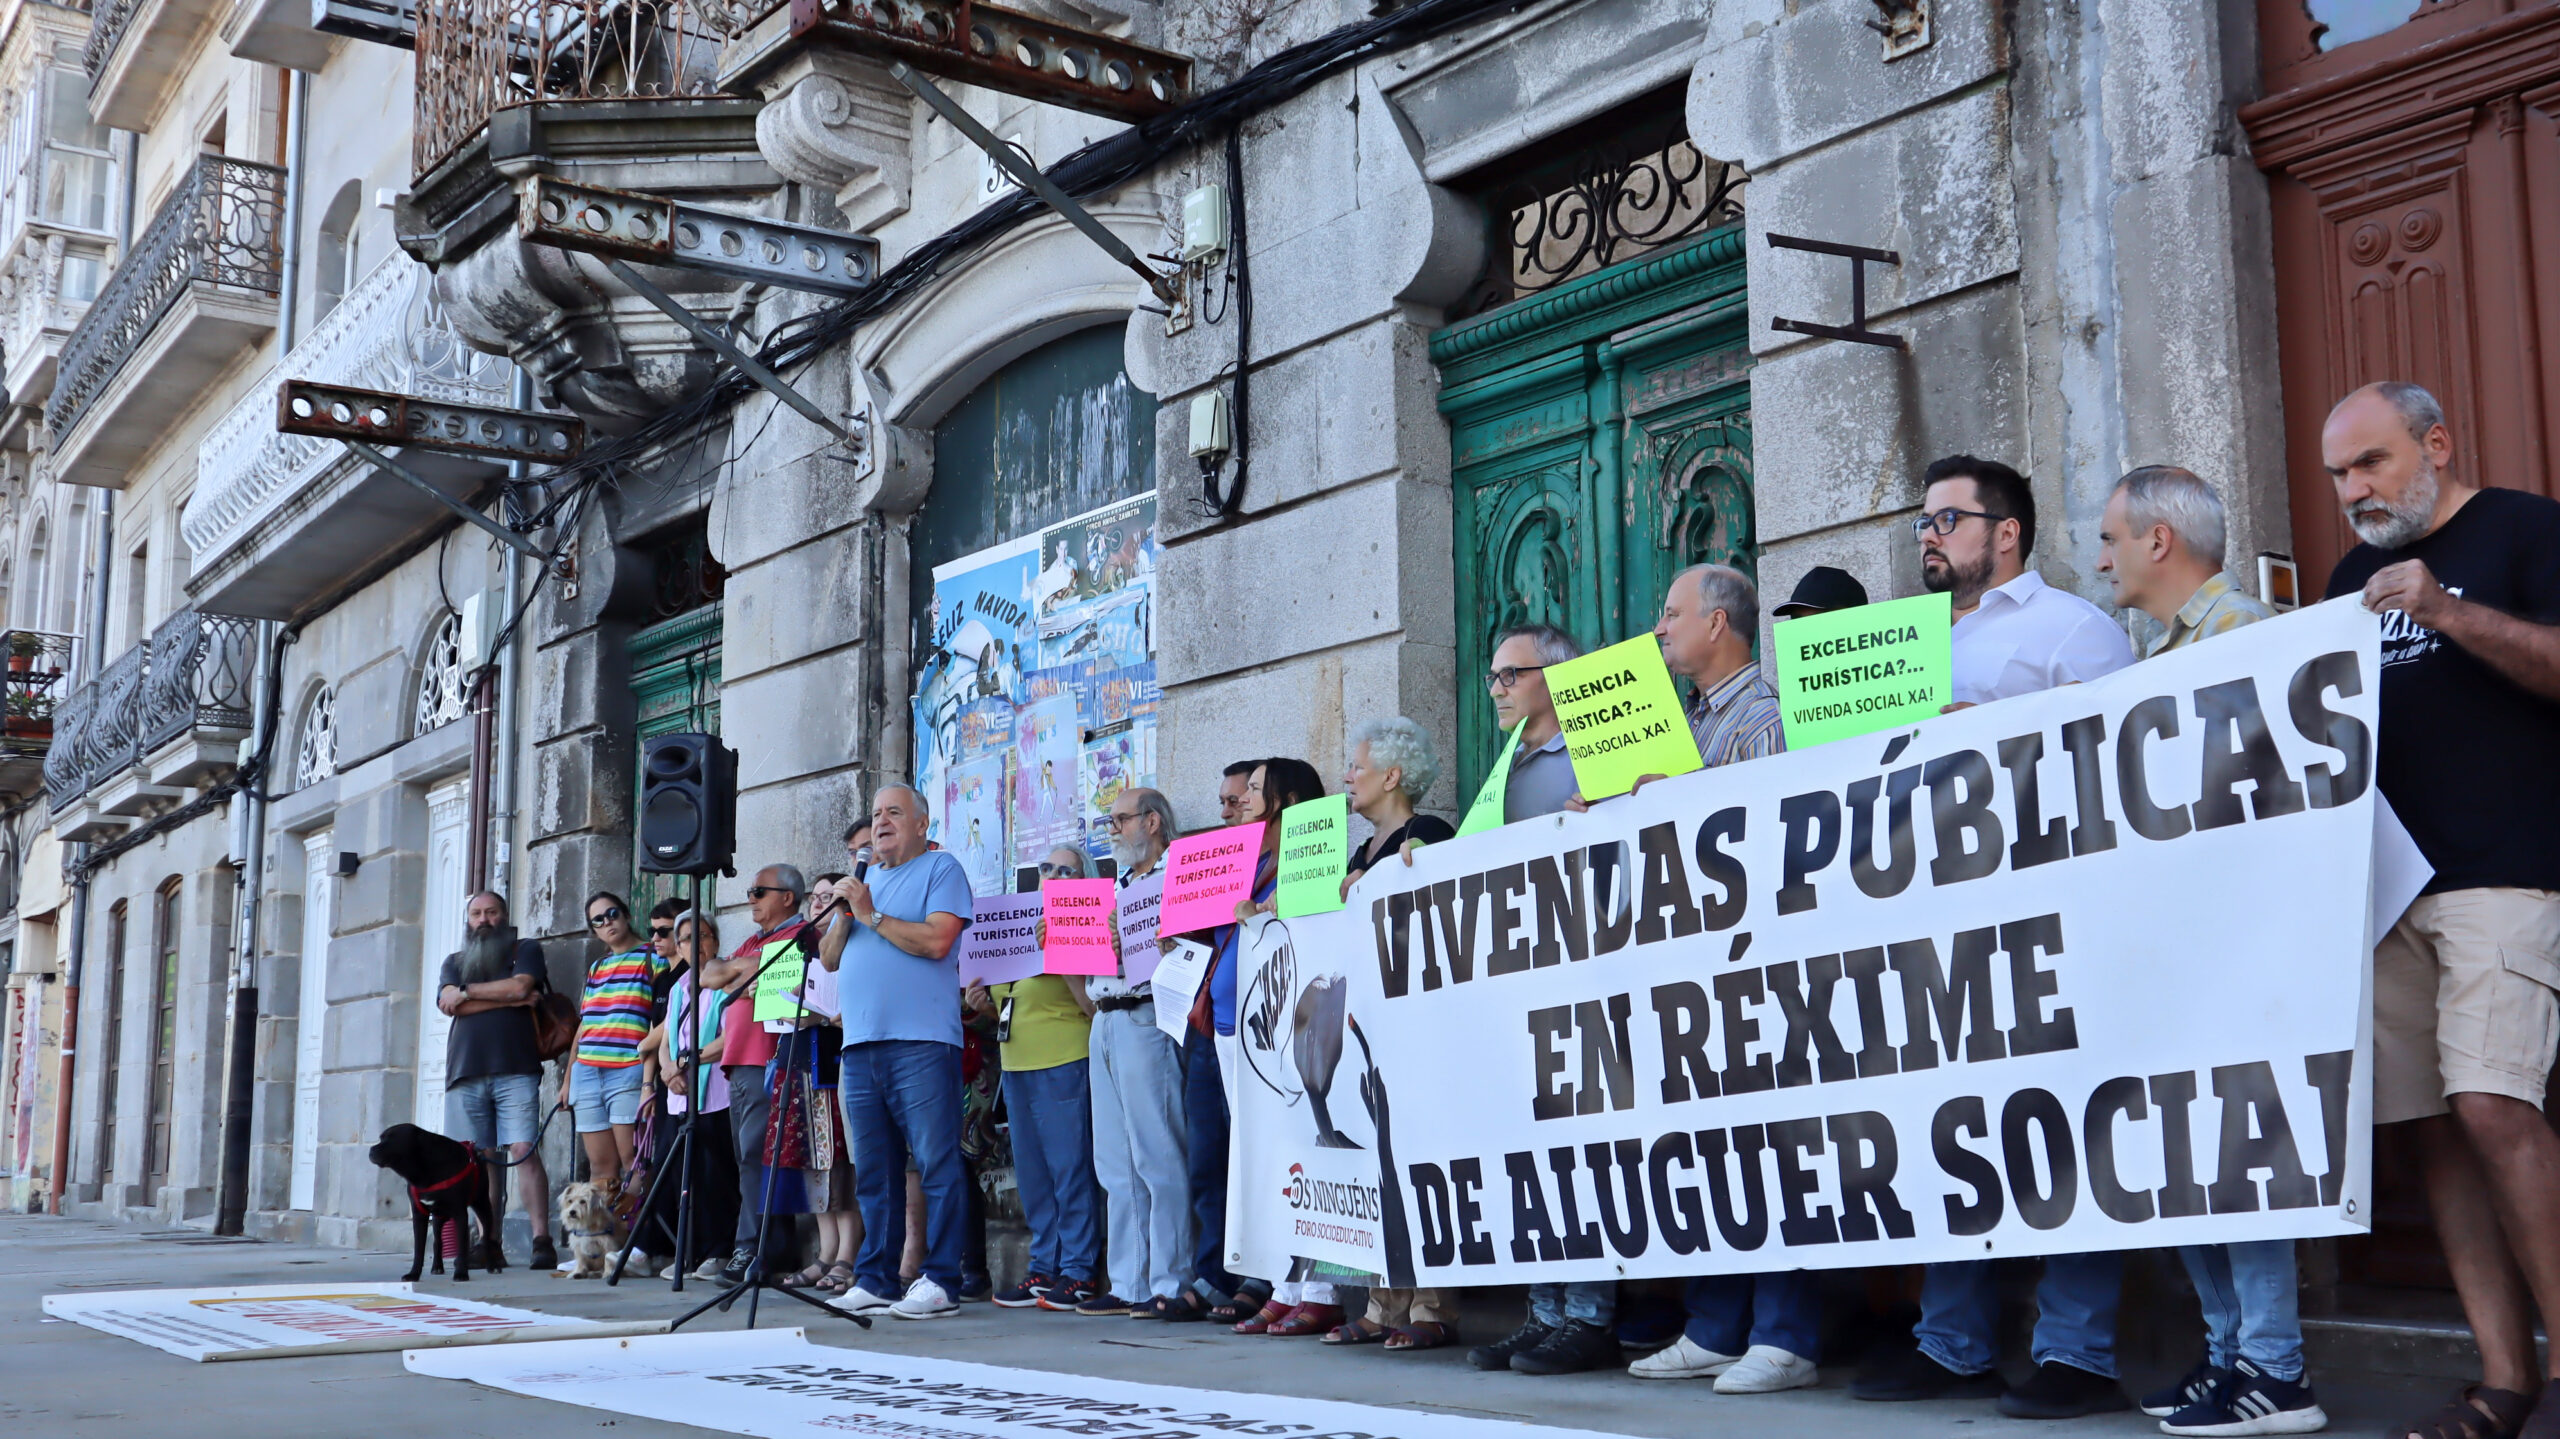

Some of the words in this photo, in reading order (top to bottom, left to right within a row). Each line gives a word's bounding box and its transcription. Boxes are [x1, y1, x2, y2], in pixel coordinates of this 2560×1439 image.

[1800, 626, 1919, 661] EXCELENCIA
[1553, 669, 1637, 706] EXCELENCIA
[1799, 659, 1925, 692] TURÍSTICA?...
[1794, 701, 1853, 724] VIVENDA
[1855, 693, 1904, 714] SOCIAL
[1908, 686, 1934, 704] XA!
[1595, 731, 1641, 755] SOCIAL
[1642, 719, 1671, 740] XA!
[1287, 818, 1334, 838] EXCELENCIA
[1372, 806, 1747, 998] VIVENDAS
[1777, 650, 2370, 914] PÚBLICAS
[1180, 843, 1244, 865] EXCELENCIA
[1281, 871, 1303, 885] VIVENDA
[1304, 867, 1325, 880] SOCIAL
[1327, 864, 1339, 876] XA!
[1051, 897, 1101, 907] EXCELENCIA
[1167, 891, 1199, 906] VIVENDA
[1200, 885, 1226, 899] SOCIAL
[1228, 881, 1244, 892] XA!
[968, 948, 1007, 959] VIVENDA
[1009, 944, 1036, 955] SOCIAL
[1048, 936, 1070, 945] VIVENDA
[1071, 936, 1094, 945] SOCIAL
[1096, 936, 1109, 945] XA!
[1123, 943, 1144, 957] VIVENDA
[1528, 992, 1634, 1120] EN
[1650, 912, 2077, 1105] RÉXIME
[1312, 1177, 1380, 1222] NINGUÉNS
[1409, 1156, 1496, 1267] DE
[1504, 1110, 1915, 1263] ALUGUER
[1295, 1219, 1317, 1238] FORO
[1317, 1222, 1375, 1249] SOCIOEDUCATIVO
[704, 1374, 803, 1387] EN
[765, 1383, 1063, 1423] SITUACIÓN
[1022, 1418, 1154, 1436] DE
[1146, 1412, 1316, 1435] DAS
